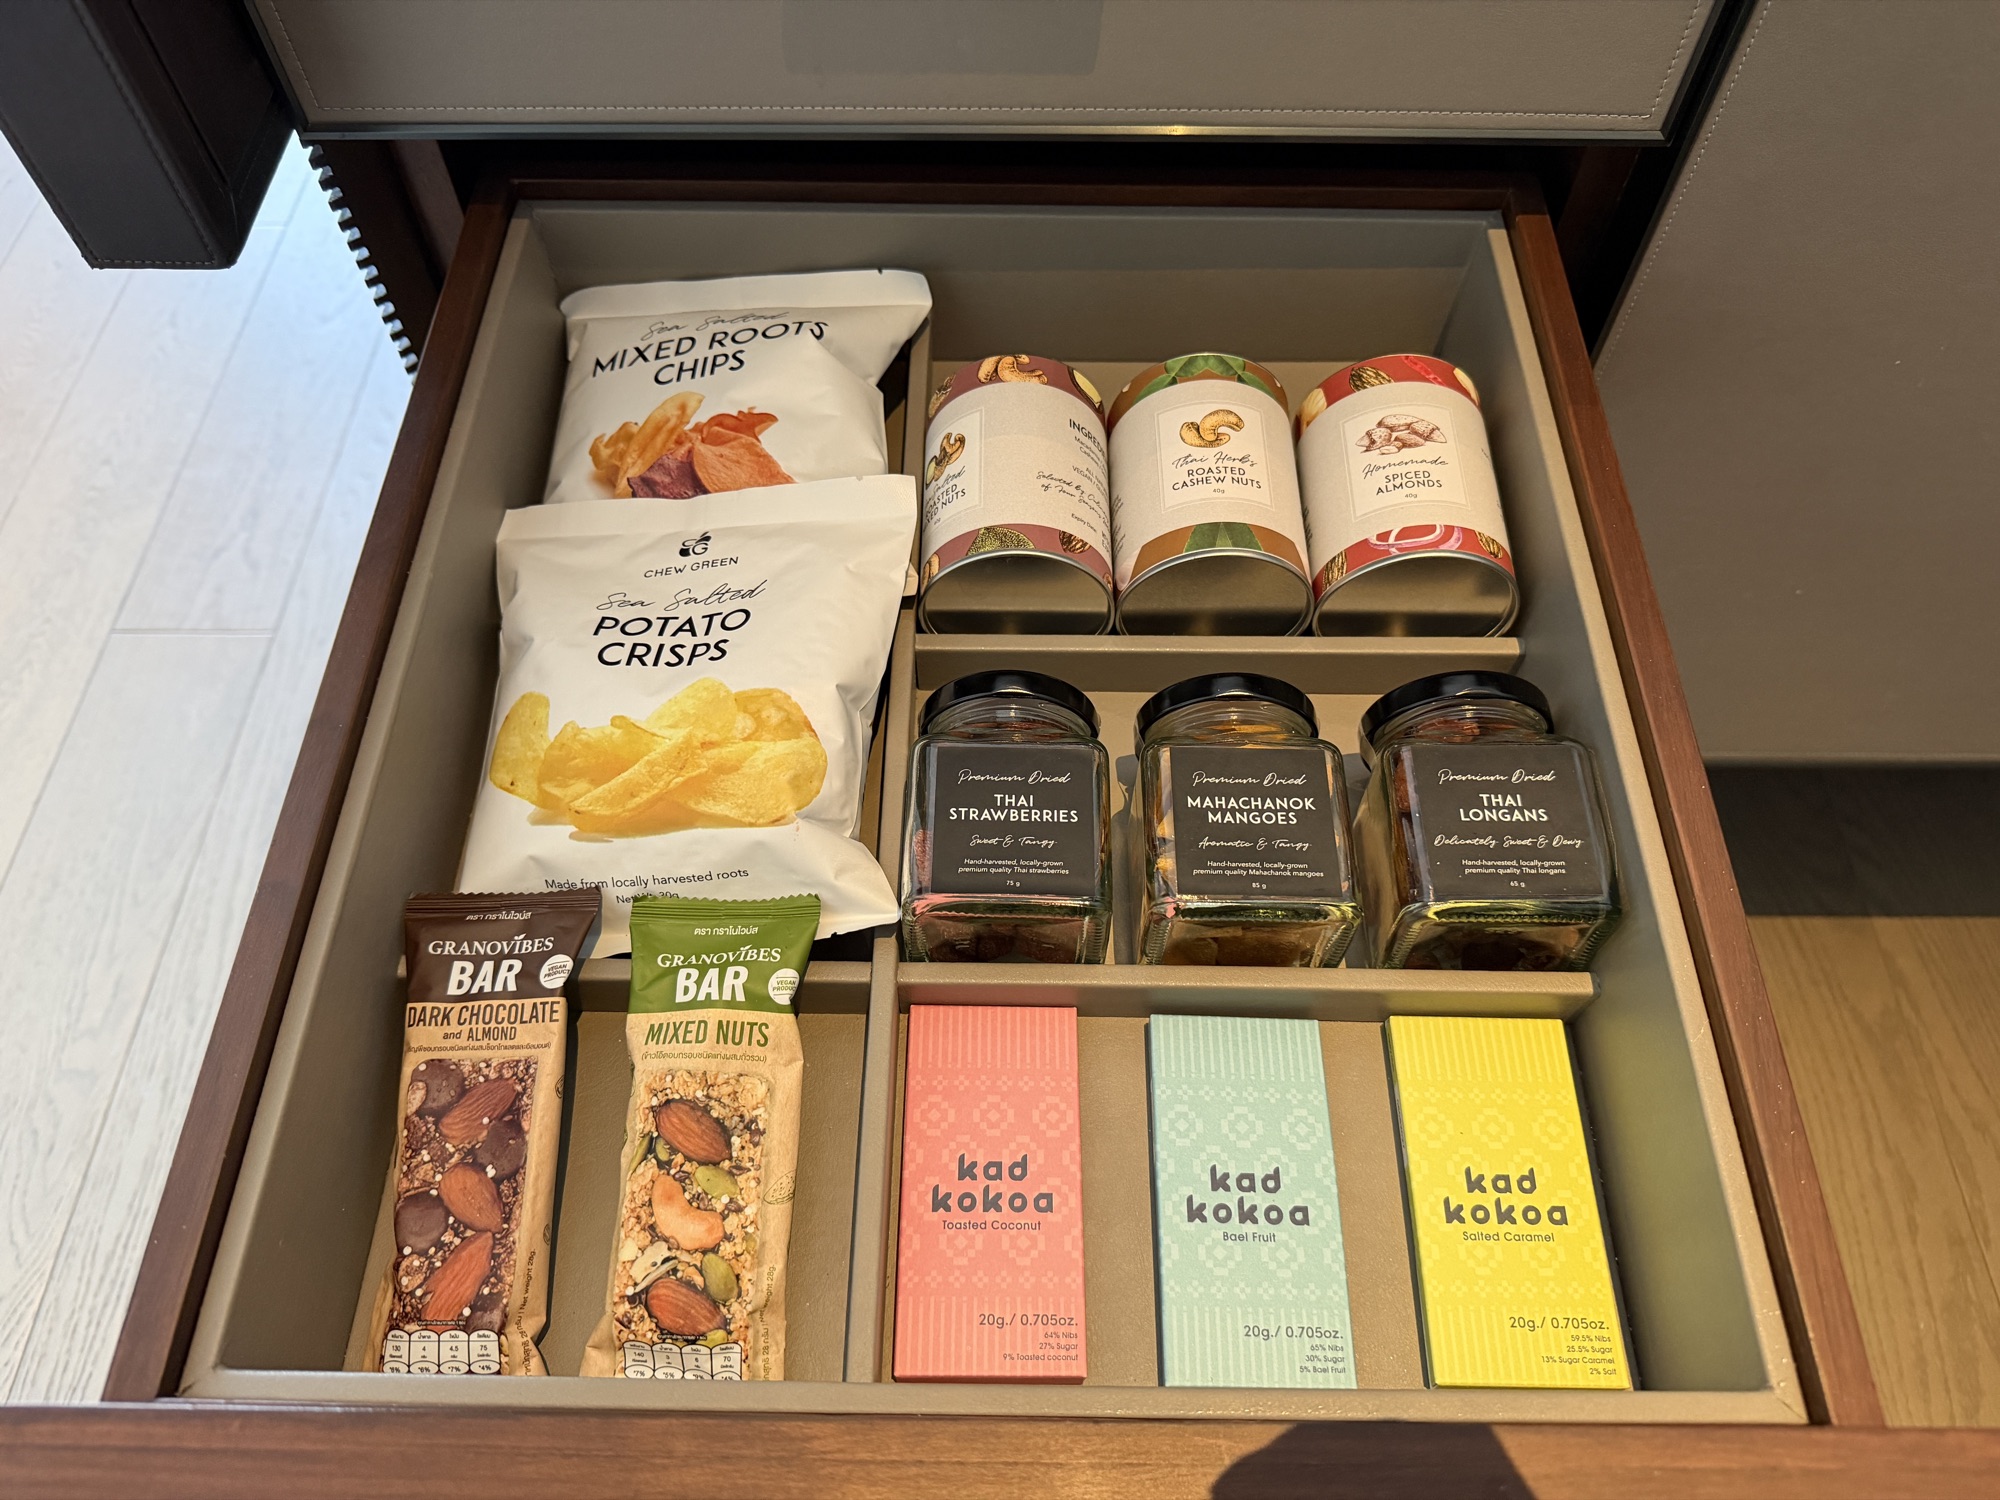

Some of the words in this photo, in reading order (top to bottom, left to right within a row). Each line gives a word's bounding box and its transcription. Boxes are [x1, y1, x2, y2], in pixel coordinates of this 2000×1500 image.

[641, 321, 688, 341] Sea
[696, 312, 789, 328] Salted
[592, 336, 696, 378] MIXED
[709, 321, 829, 350] ROOTS
[654, 350, 746, 386] CHIPS
[1172, 454, 1208, 469] Thai
[1214, 451, 1258, 467] Herbs
[1362, 456, 1448, 479] Homemade
[1036, 471, 1073, 486] Selected
[1188, 466, 1245, 477] ROASTED
[1385, 471, 1430, 483] SPICED
[1172, 476, 1226, 491] CASHEW
[1232, 477, 1262, 489] NUTS
[1376, 480, 1442, 495] ALMONDS
[941, 488, 966, 509] NUTS
[644, 565, 687, 578] CHEW
[690, 556, 739, 571] GREEN
[596, 592, 655, 610] Sea
[664, 579, 767, 612] Salted
[592, 608, 751, 638] POTATO
[597, 638, 729, 667] CRISPS
[958, 769, 1025, 784] Premium
[1028, 771, 1071, 784] Dried
[1192, 771, 1260, 786] Premium
[1263, 773, 1306, 786] Dried
[1438, 769, 1508, 784] Premium
[1511, 769, 1556, 784] Dried
[994, 794, 1033, 806] THAI
[1187, 796, 1316, 810] MAHACHANOK
[1479, 794, 1522, 806] THAI
[950, 808, 1078, 822] STRAWBERRIES
[1208, 811, 1297, 824] MANGOES
[1460, 808, 1548, 822] LONGANS
[970, 834, 1003, 846] Sweet
[1003, 835, 1014, 847] &
[1019, 836, 1058, 848] Tangy
[1199, 837, 1253, 849] Aromatic
[1256, 838, 1267, 850] &
[1272, 839, 1312, 851] Tangy
[1434, 834, 1498, 848] Delicately
[1503, 836, 1537, 847] Sweet
[1537, 835, 1548, 848] &
[1552, 835, 1584, 848] Dewy
[964, 858, 1018, 866] Hand-harvested,
[545, 879, 577, 889] Made
[581, 878, 608, 889] from
[612, 876, 649, 889] locally
[652, 871, 713, 886] harvested
[717, 868, 749, 880] roots
[990, 867, 1012, 875] quality
[428, 935, 554, 955] GRANOVIBES
[657, 946, 782, 968] GRANOVIBES
[447, 959, 522, 995] BAR
[544, 970, 570, 978] PRODUCT
[675, 966, 748, 1003] BAR
[408, 1006, 455, 1028] DARK
[457, 1000, 560, 1025] CHOCOLATE
[443, 1030, 461, 1040] and
[467, 1026, 516, 1041] ALMOND
[645, 1020, 708, 1046] MIXED
[716, 1020, 770, 1047] NUTS
[957, 1153, 1028, 1181] kad
[1210, 1164, 1281, 1193] kad
[1465, 1166, 1537, 1194] kad
[931, 1184, 1054, 1213] kokoa
[1187, 1194, 1310, 1226] kokoa
[1443, 1196, 1568, 1226] kokoa
[942, 1220, 987, 1230] Toasted
[991, 1220, 1041, 1230] Coconut
[1222, 1232, 1248, 1242] Bael
[1252, 1232, 1276, 1242] Fruit
[1462, 1231, 1500, 1241] Salted
[1504, 1232, 1555, 1242] Caramel
[766, 1264, 776, 1282] 28g.
[520, 1296, 528, 1311] Net
[524, 1267, 534, 1296] weight
[1020, 1314, 1078, 1326] 0.705oz.
[1550, 1317, 1610, 1330] 0.705oz.
[1044, 1331, 1060, 1339] 64%
[1062, 1331, 1078, 1339] Nibs
[1285, 1327, 1344, 1340] 0.705oz.
[1571, 1335, 1593, 1343] 59.5%
[1595, 1335, 1611, 1343] Nibs
[762, 1346, 770, 1356] 28
[1039, 1342, 1054, 1350] 27%
[1057, 1342, 1078, 1351] Sugar
[1328, 1344, 1344, 1352] Nibs
[1566, 1345, 1589, 1353] 25.5%
[1591, 1346, 1612, 1355] Sugar
[1003, 1353, 1014, 1361] 9%
[1016, 1353, 1045, 1361] Toasted
[1047, 1353, 1078, 1361] coconut
[1305, 1355, 1321, 1363] 30%
[1323, 1355, 1345, 1364] Sugar
[1541, 1355, 1557, 1363] 13%
[1558, 1356, 1580, 1365] Sugar
[1582, 1356, 1615, 1364] Caramel
[1331, 1366, 1346, 1374] Fruit
[1589, 1367, 1601, 1375] 2%
[1603, 1367, 1616, 1376] Salt
